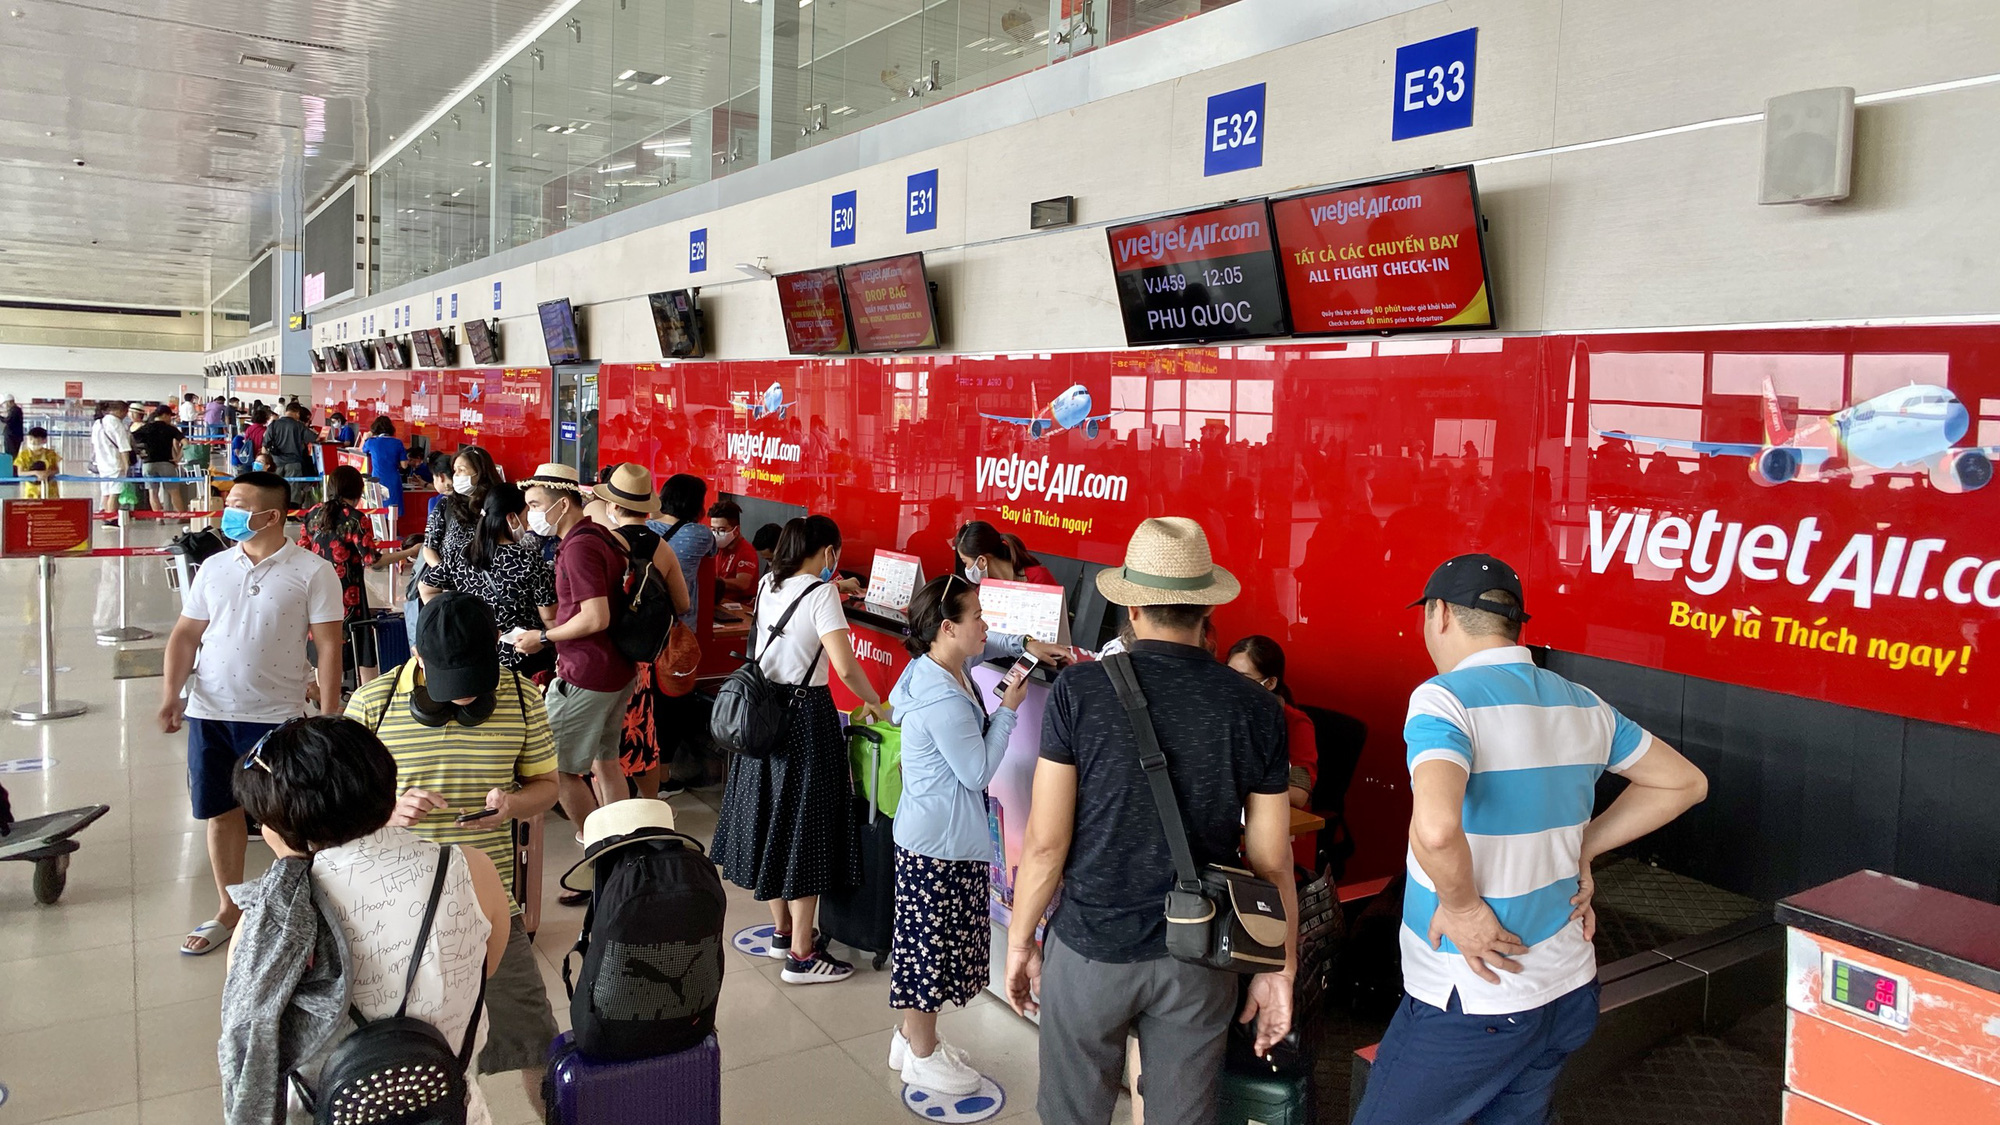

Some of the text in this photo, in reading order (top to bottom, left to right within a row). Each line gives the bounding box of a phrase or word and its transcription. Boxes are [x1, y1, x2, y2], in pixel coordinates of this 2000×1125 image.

[1404, 60, 1466, 112] E33
[1212, 110, 1258, 152] E32
[910, 187, 934, 217] E31
[834, 208, 854, 233] E30
[691, 241, 705, 261] E29
[1294, 234, 1459, 265] TẤT CẢ CÁC CHUYẾN BAY
[1144, 266, 1243, 294] VJ459 12:05
[1309, 257, 1450, 283] ALL FLIGHT CHECK-IN
[865, 286, 907, 302] DROP BAG
[1147, 301, 1252, 330] PHU QUOC
[1366, 317, 1375, 325] 40
[1376, 316, 1394, 324] mins
[1416, 315, 1443, 323] departure
[1374, 306, 1383, 314] 40
[1385, 304, 1401, 314] phút
[761, 436, 801, 465] Air.com
[1044, 463, 1128, 503] Air.com
[1002, 505, 1093, 535] Bay là Thích ngay!
[855, 638, 893, 667] Air.com
[1669, 601, 1972, 676] Bay là Thích ngay!
